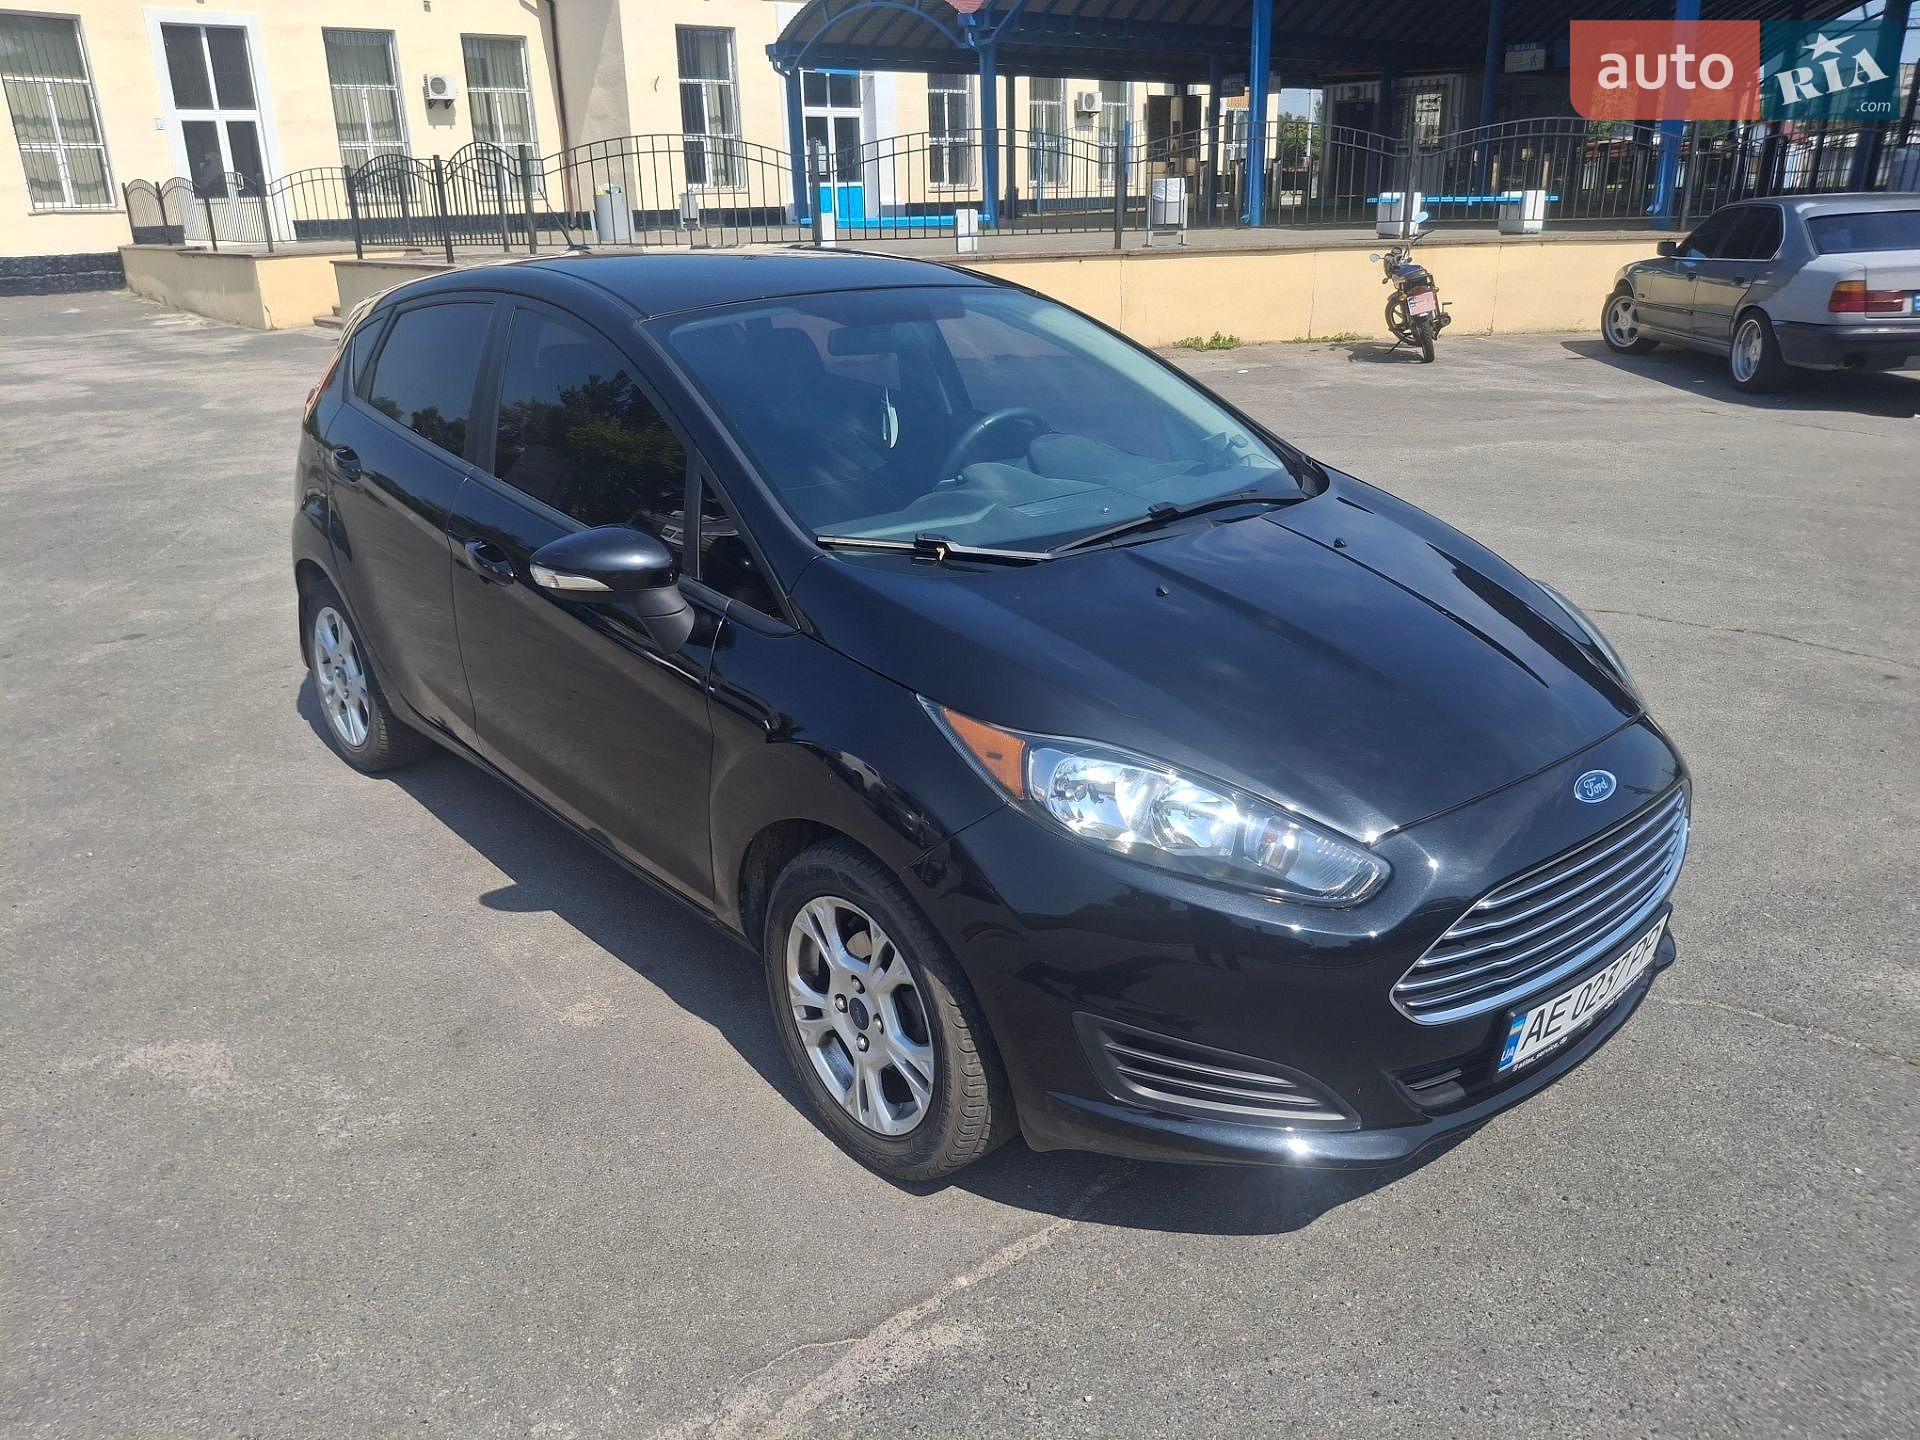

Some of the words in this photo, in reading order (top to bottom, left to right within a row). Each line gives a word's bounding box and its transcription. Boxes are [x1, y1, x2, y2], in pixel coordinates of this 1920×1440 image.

[1583, 776, 1609, 797] Ford
[1519, 994, 1572, 1050] AE
[1571, 949, 1633, 1021] 0237
[1625, 923, 1661, 977] PP
[1500, 1046, 1514, 1062] UA
